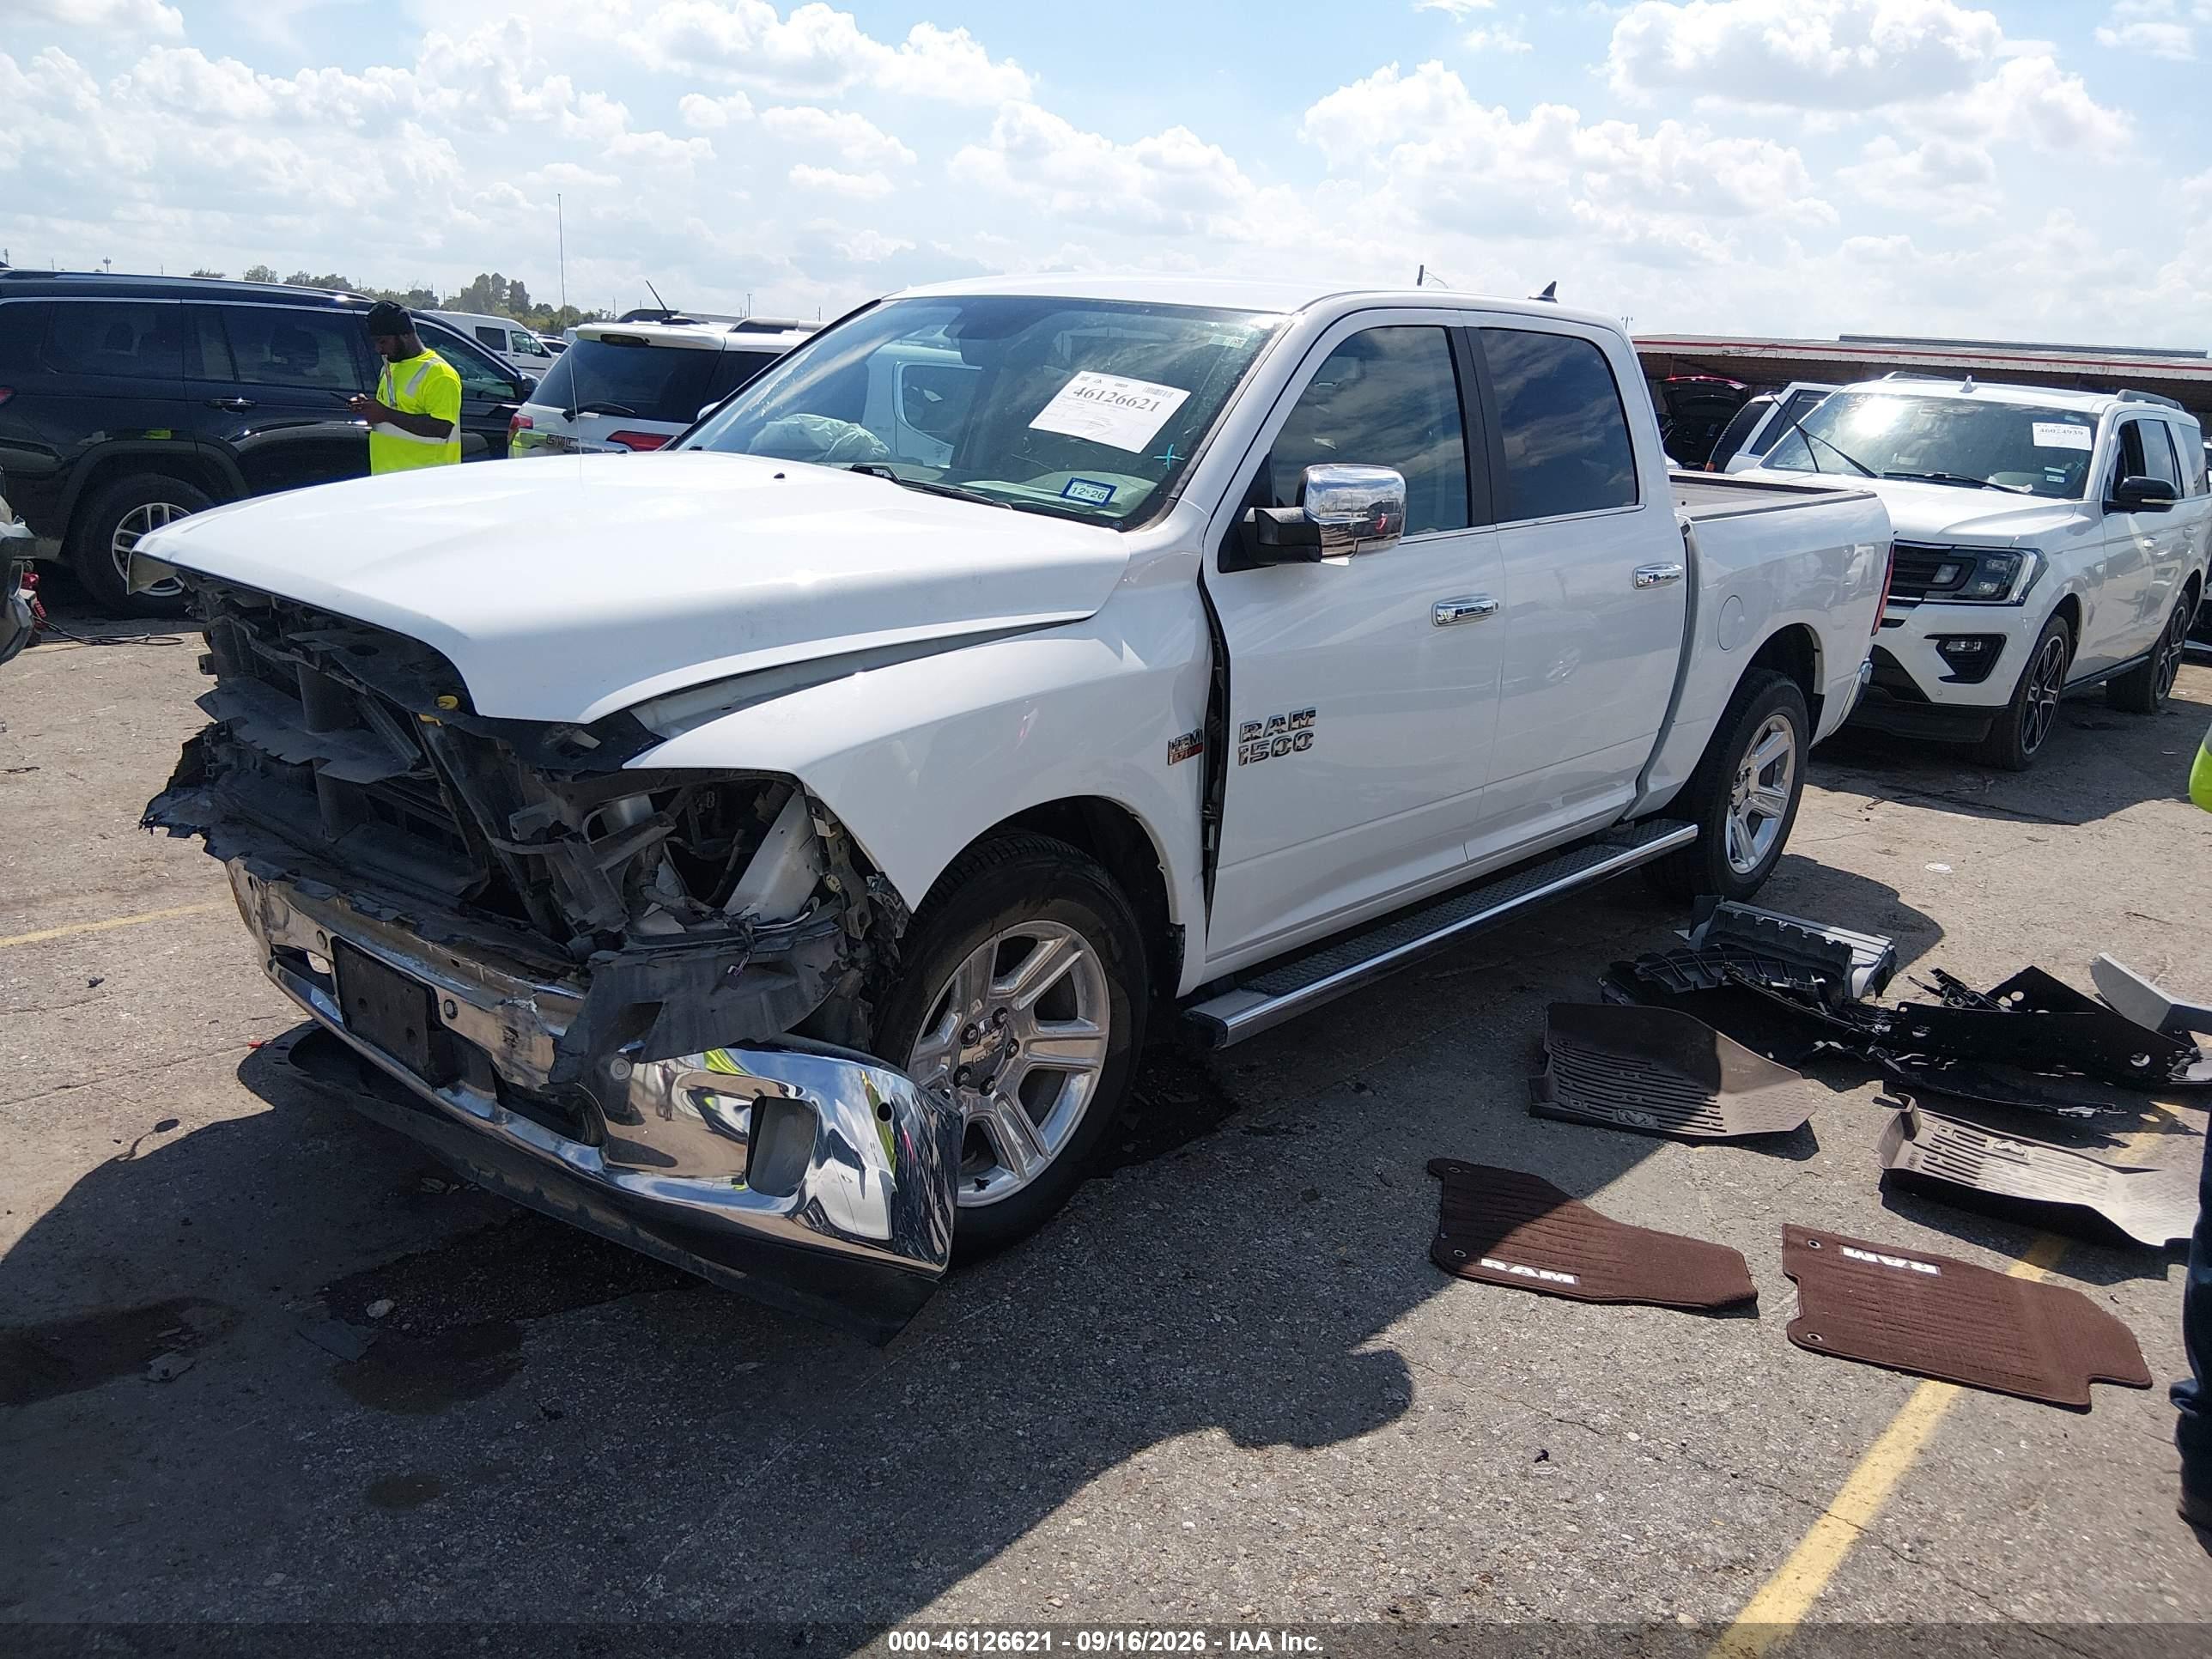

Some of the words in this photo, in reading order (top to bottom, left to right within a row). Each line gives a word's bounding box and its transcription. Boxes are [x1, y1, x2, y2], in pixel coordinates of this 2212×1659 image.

[1073, 387, 1161, 412] 46126621
[546, 433, 579, 448] GMC
[1239, 707, 1316, 744] RAM
[1238, 730, 1314, 766] 1500
[1480, 1257, 1577, 1285] RAM
[1842, 1247, 1938, 1274] RAM
